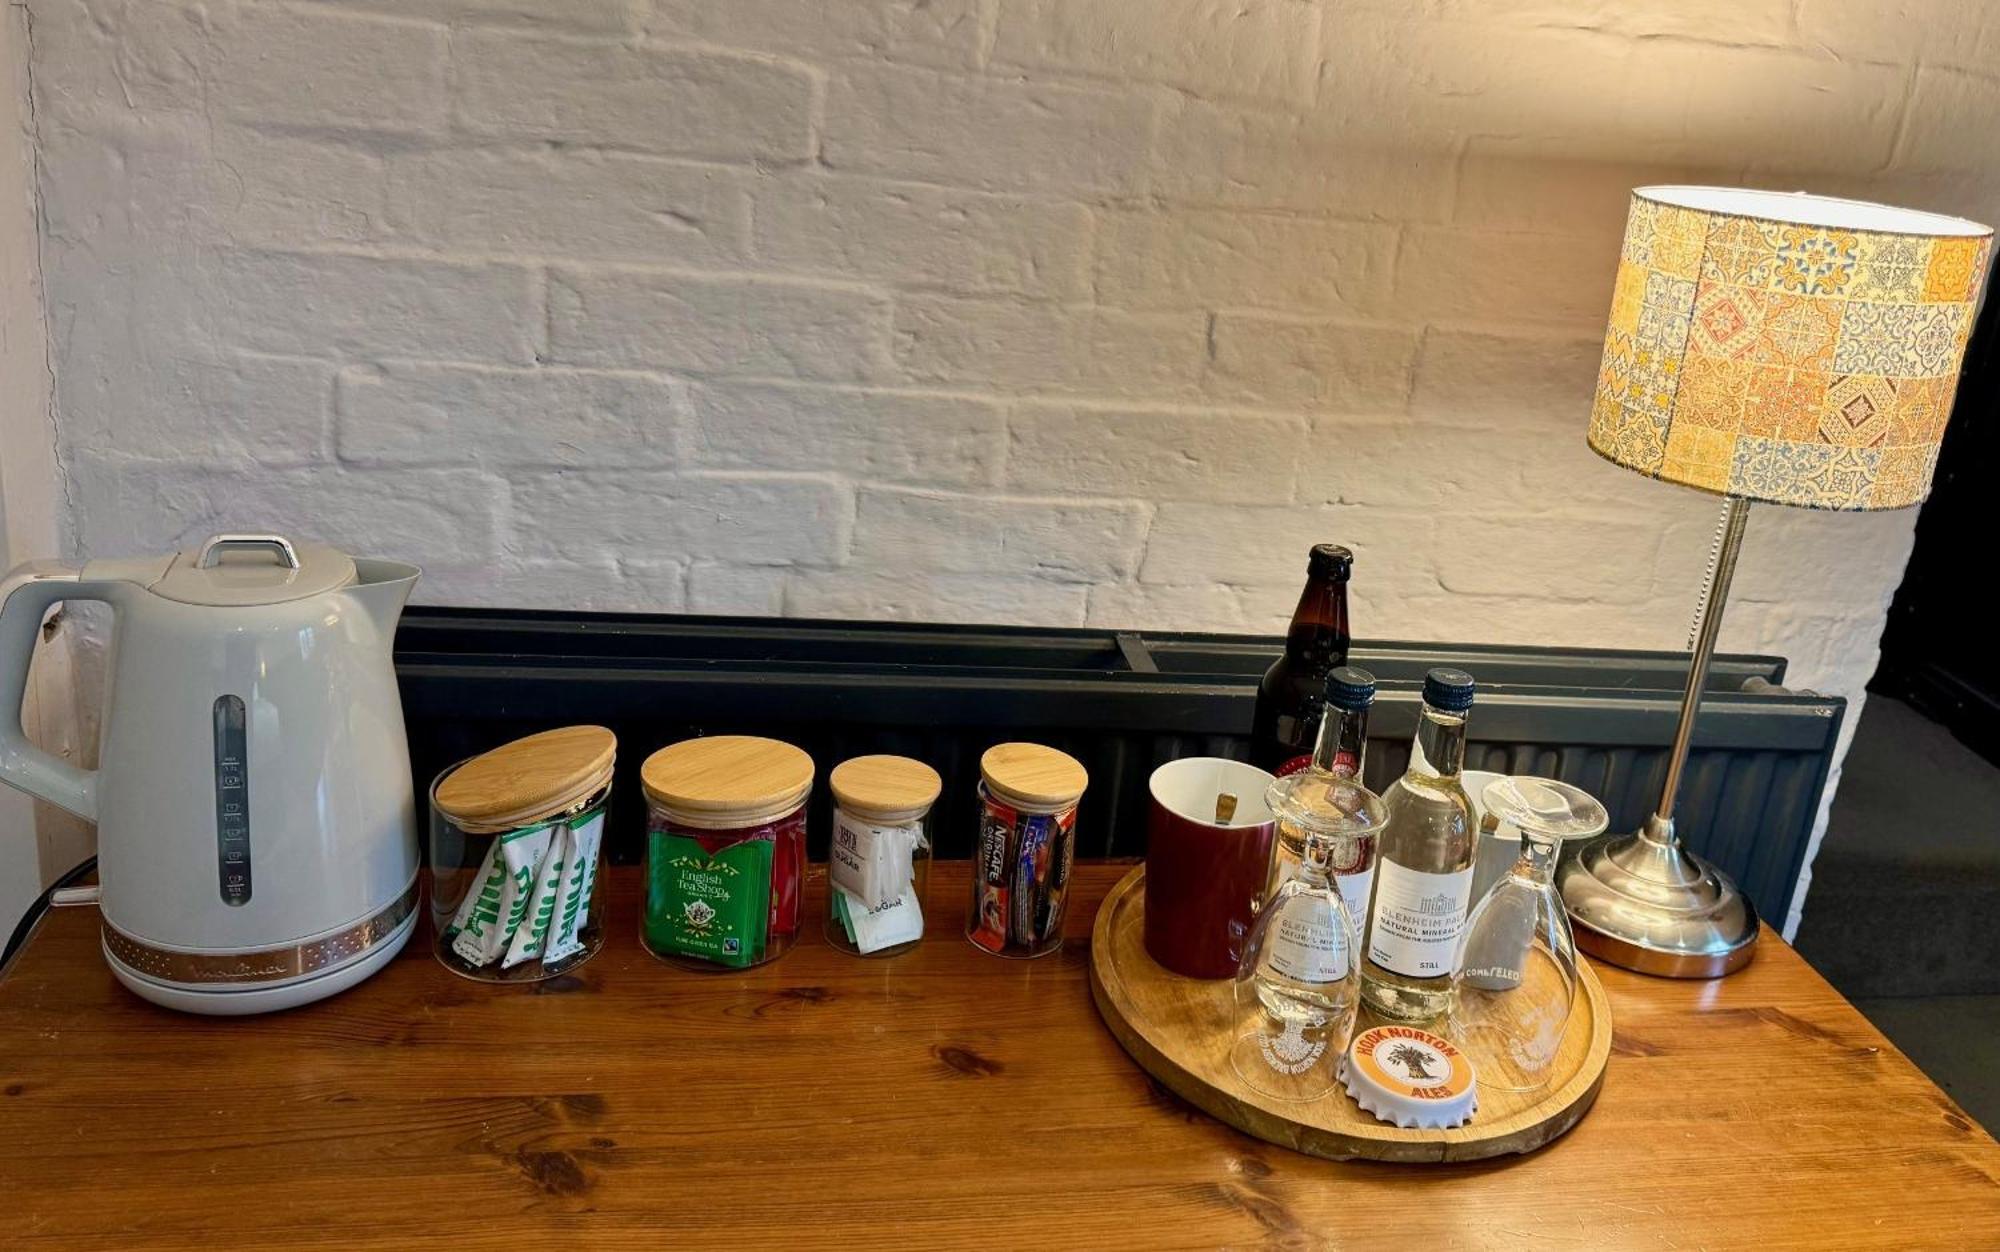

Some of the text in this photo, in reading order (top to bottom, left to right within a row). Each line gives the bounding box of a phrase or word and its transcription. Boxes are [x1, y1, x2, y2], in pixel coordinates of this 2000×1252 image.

[677, 879, 696, 891] Tea
[681, 869, 722, 884] English
[1382, 906, 1441, 928] BLENHEIM
[1380, 917, 1418, 936] NATURAL
[1421, 928, 1455, 936] MINERAL
[1356, 1027, 1459, 1058] HOOK NORTON
[1410, 1086, 1453, 1099] ALES
